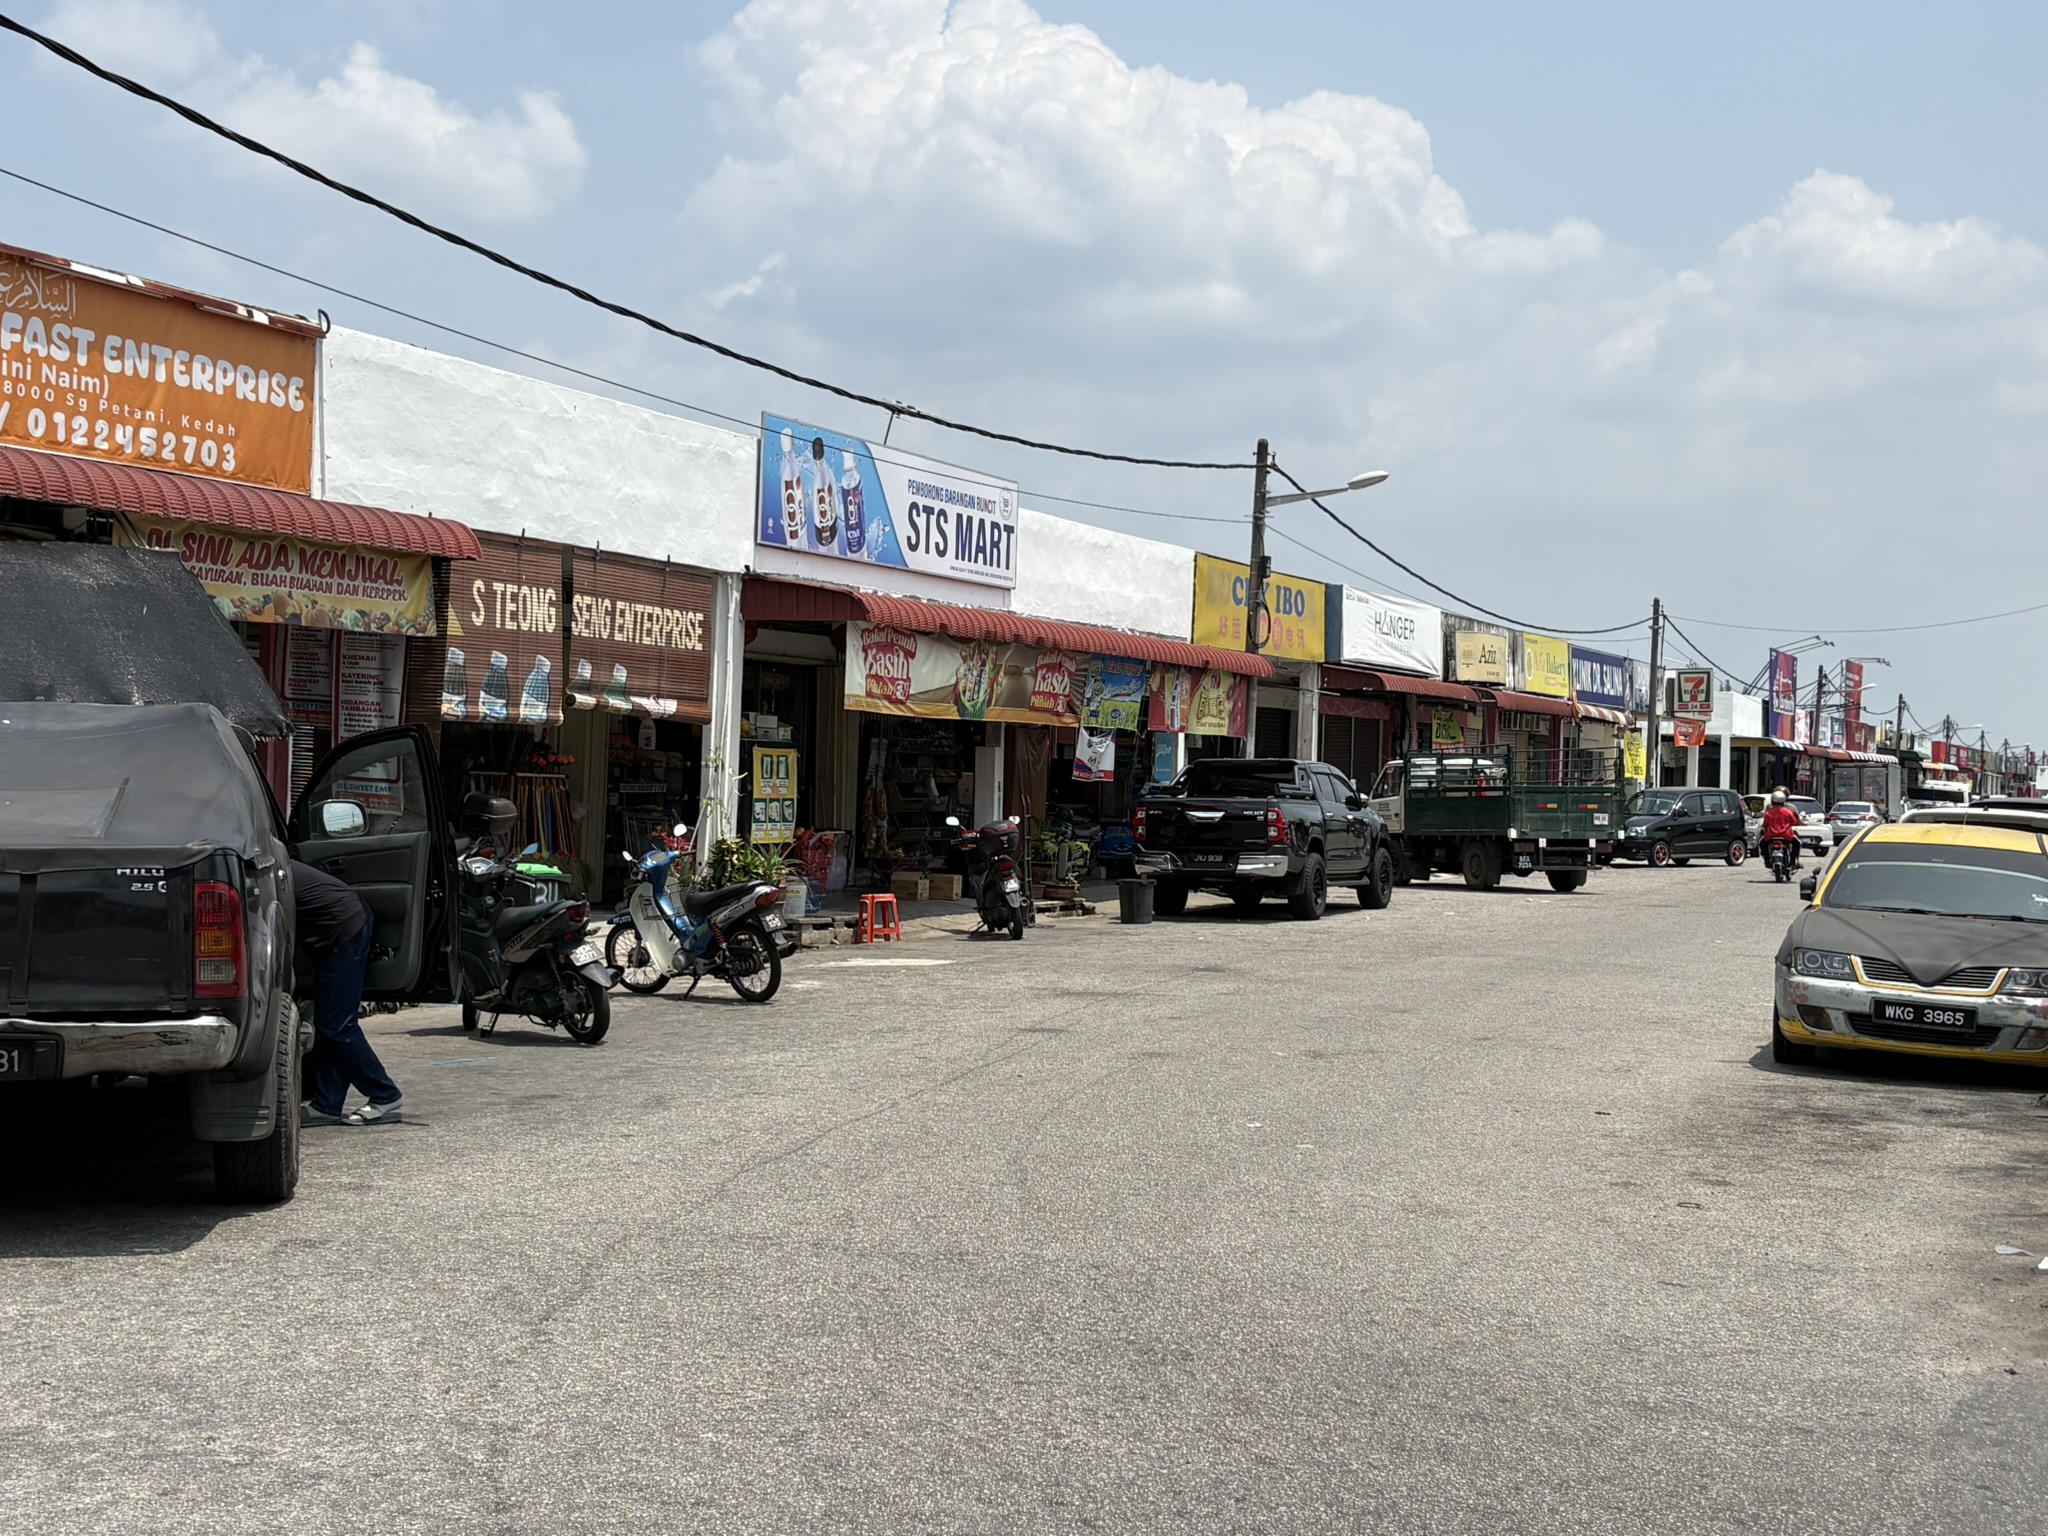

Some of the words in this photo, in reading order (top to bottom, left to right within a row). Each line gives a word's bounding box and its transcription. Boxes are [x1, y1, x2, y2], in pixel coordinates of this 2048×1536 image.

[1, 312, 95, 366] FAST
[103, 335, 305, 412] ENTERPRISE
[41, 362, 110, 399] Naim)
[66, 393, 88, 412] Sg
[99, 397, 171, 426] Petani,
[182, 414, 236, 438] Kedah
[27, 408, 237, 472] 0122452703
[908, 479, 944, 503] PEMBORONG
[944, 488, 976, 510] BARANGAN
[976, 496, 997, 515] BUNCIT
[906, 501, 949, 559] STS
[955, 512, 1015, 571] MART
[180, 532, 234, 567] SINI
[236, 541, 293, 571] ADA
[298, 546, 404, 587] MENJUAL
[250, 573, 287, 589] BUAH
[288, 575, 333, 595] BUAHAN
[336, 582, 360, 597] DAN
[361, 584, 408, 602] KEREPEK
[1275, 584, 1306, 618] IBO
[492, 582, 556, 633] TEONG
[571, 592, 612, 641] SENG
[614, 600, 704, 651] ENTERPRISE
[1374, 609, 1415, 642] HANGER
[888, 630, 916, 653] Penuh
[1478, 643, 1497, 665] Aziz
[865, 646, 908, 680] Kasih
[1885, 1005, 1914, 1021] WKG
[1923, 1009, 1965, 1026] 3965
